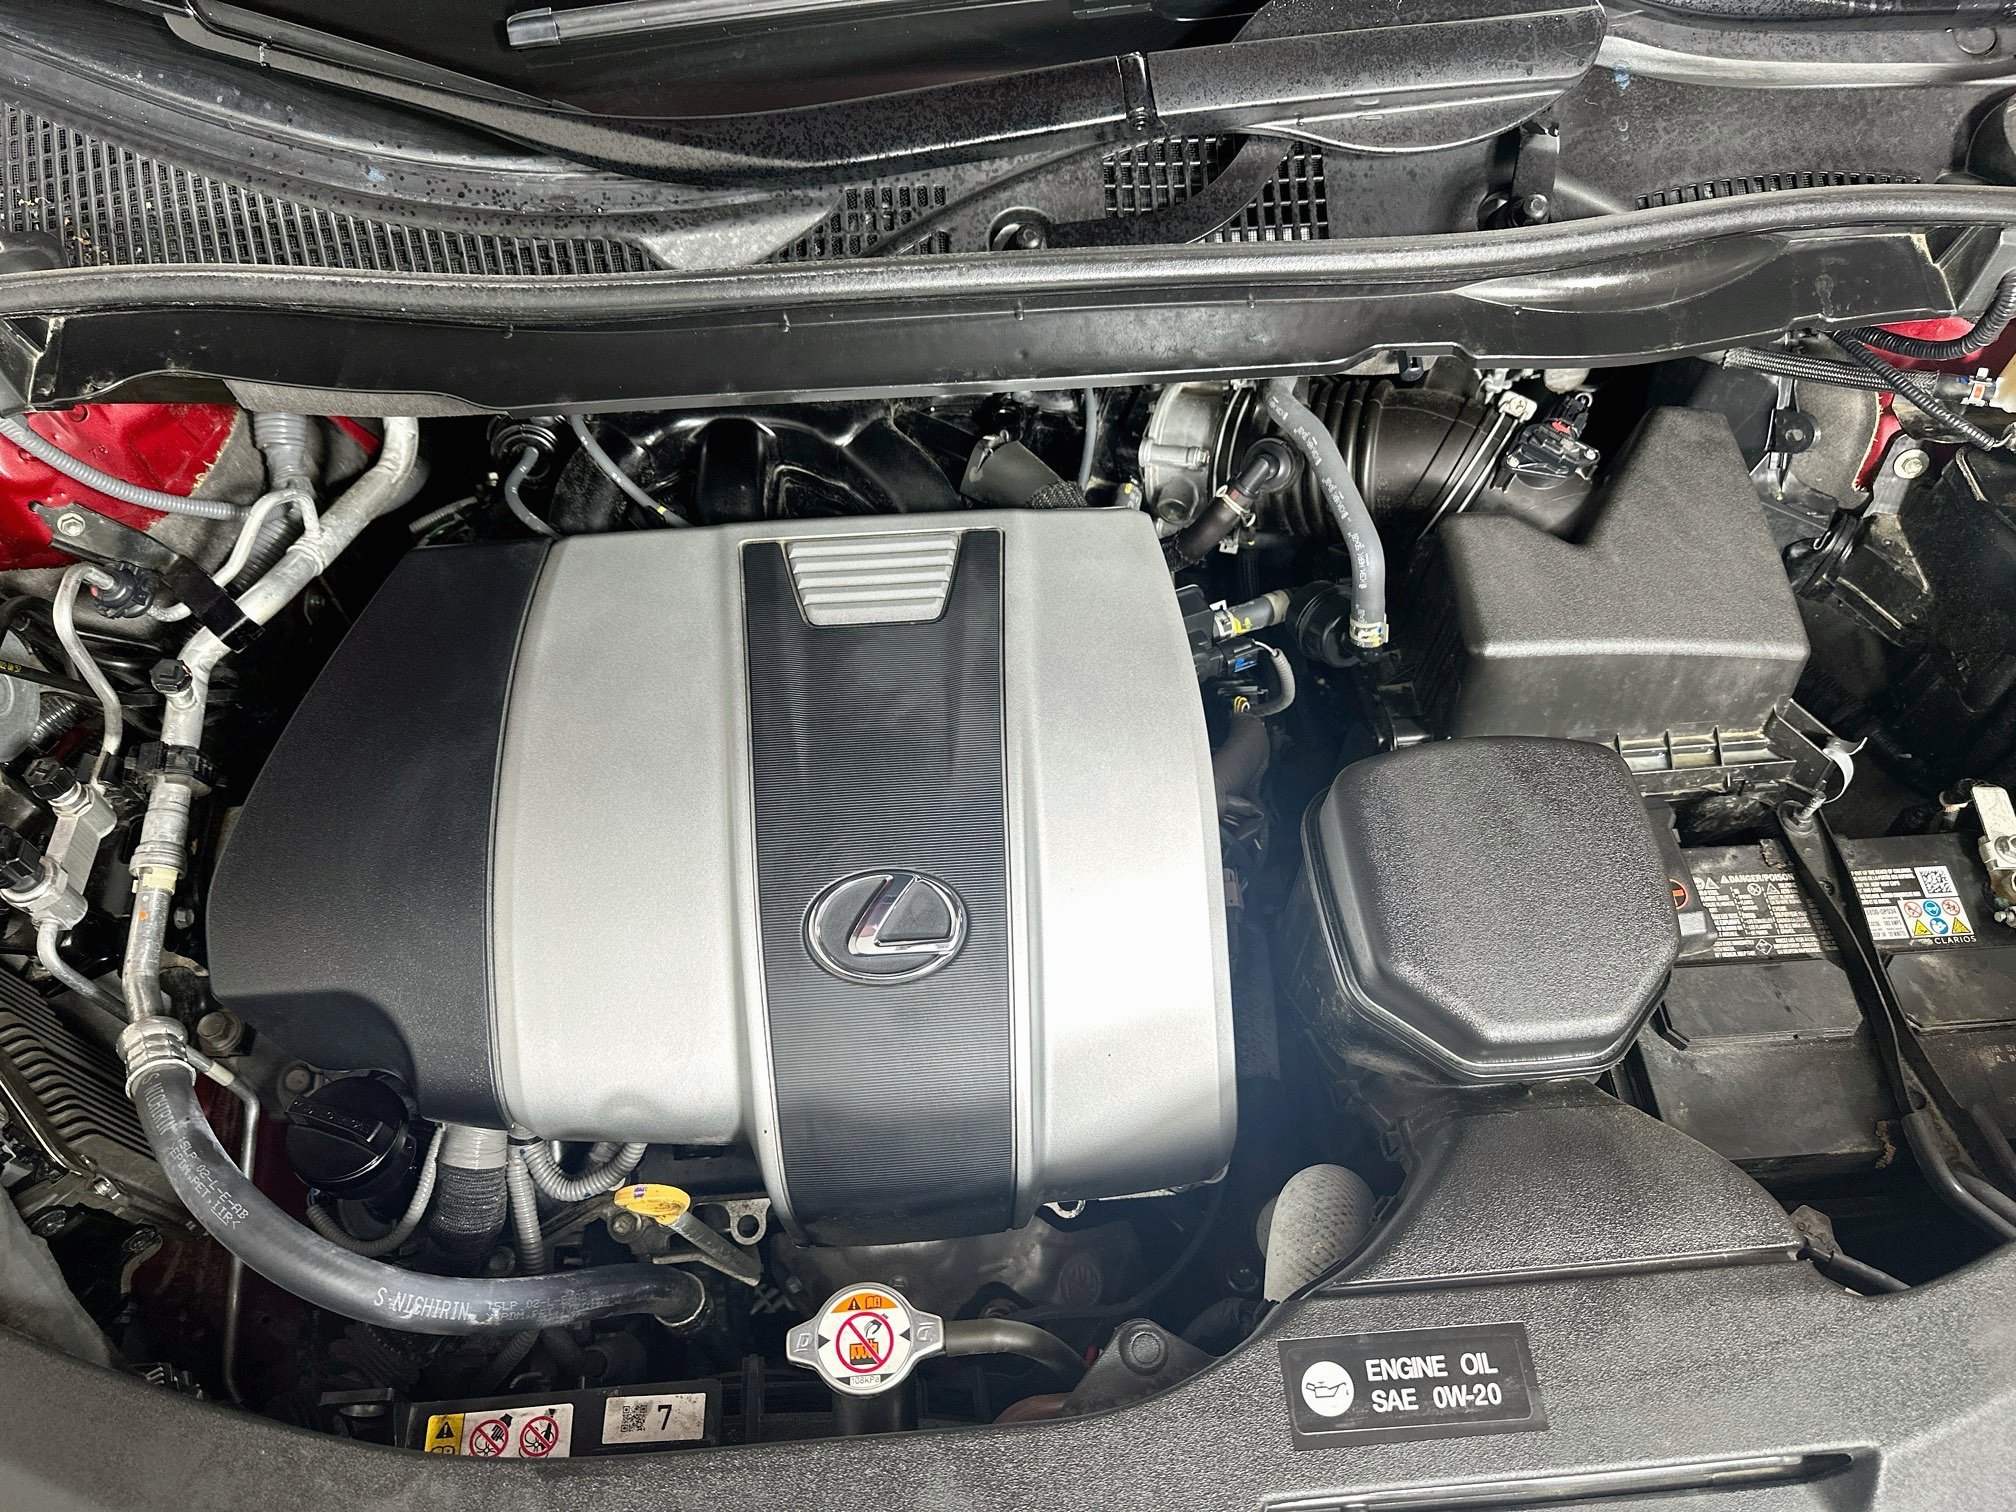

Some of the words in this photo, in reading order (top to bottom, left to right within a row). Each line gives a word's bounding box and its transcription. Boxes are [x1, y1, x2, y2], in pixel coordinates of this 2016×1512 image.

[1728, 873, 1795, 883] DANGER/POISON
[1934, 935, 1977, 945] CLARIOS
[1365, 1355, 1448, 1382] ENGINE
[1460, 1352, 1499, 1377] OIL
[1371, 1388, 1419, 1413] SAE
[1432, 1382, 1502, 1409] 0W-20
[657, 1404, 673, 1431] 7
